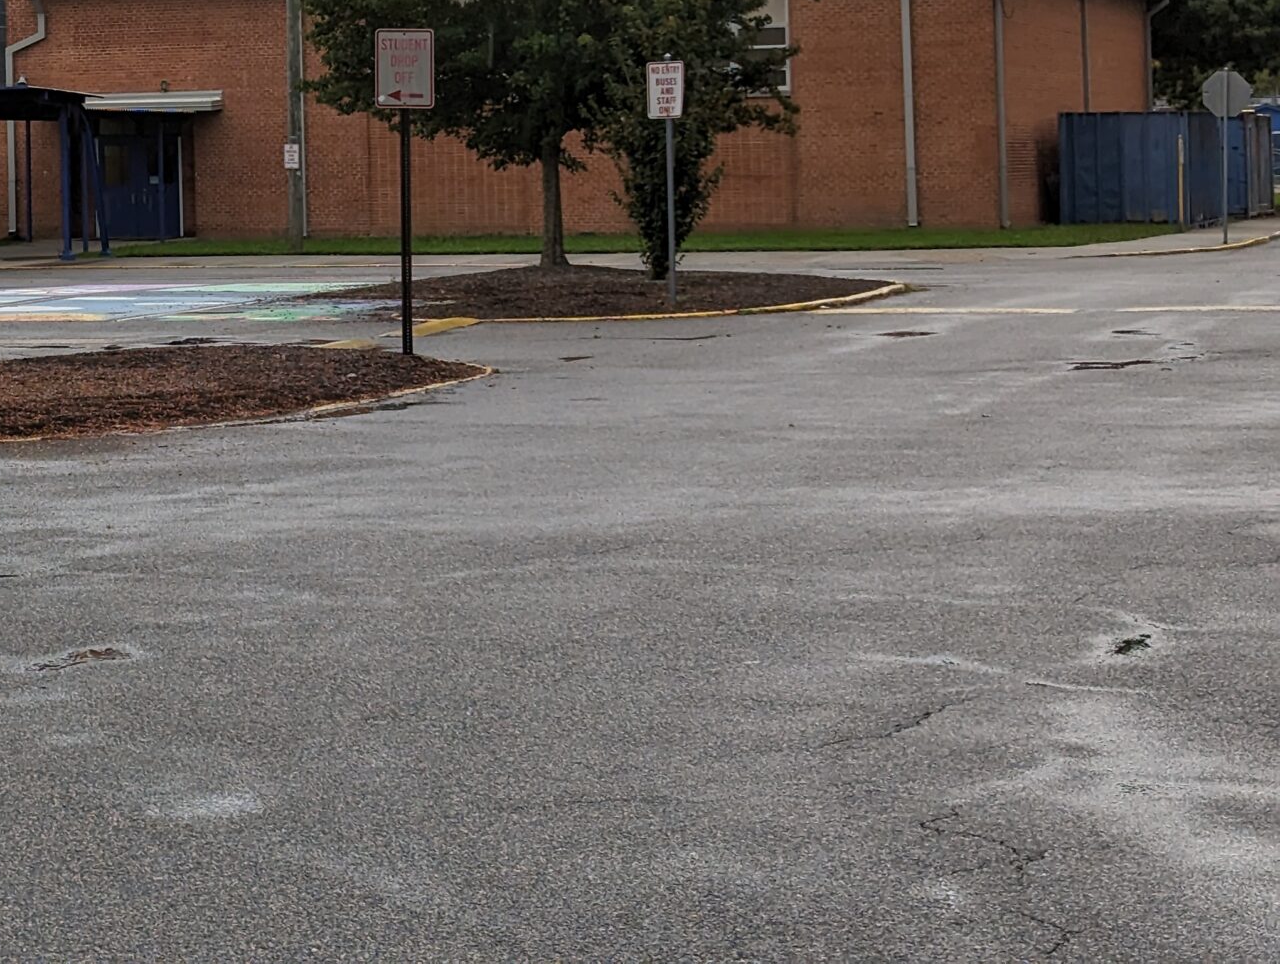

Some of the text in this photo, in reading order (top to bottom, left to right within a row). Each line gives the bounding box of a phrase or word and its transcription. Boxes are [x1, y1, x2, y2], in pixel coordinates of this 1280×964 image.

[381, 38, 428, 50] STUDENT
[390, 55, 418, 67] DROP
[651, 66, 660, 74] NO
[394, 71, 414, 84] OFF
[655, 77, 676, 86] BUSES
[661, 87, 674, 95] AND
[657, 96, 676, 105] STAFF
